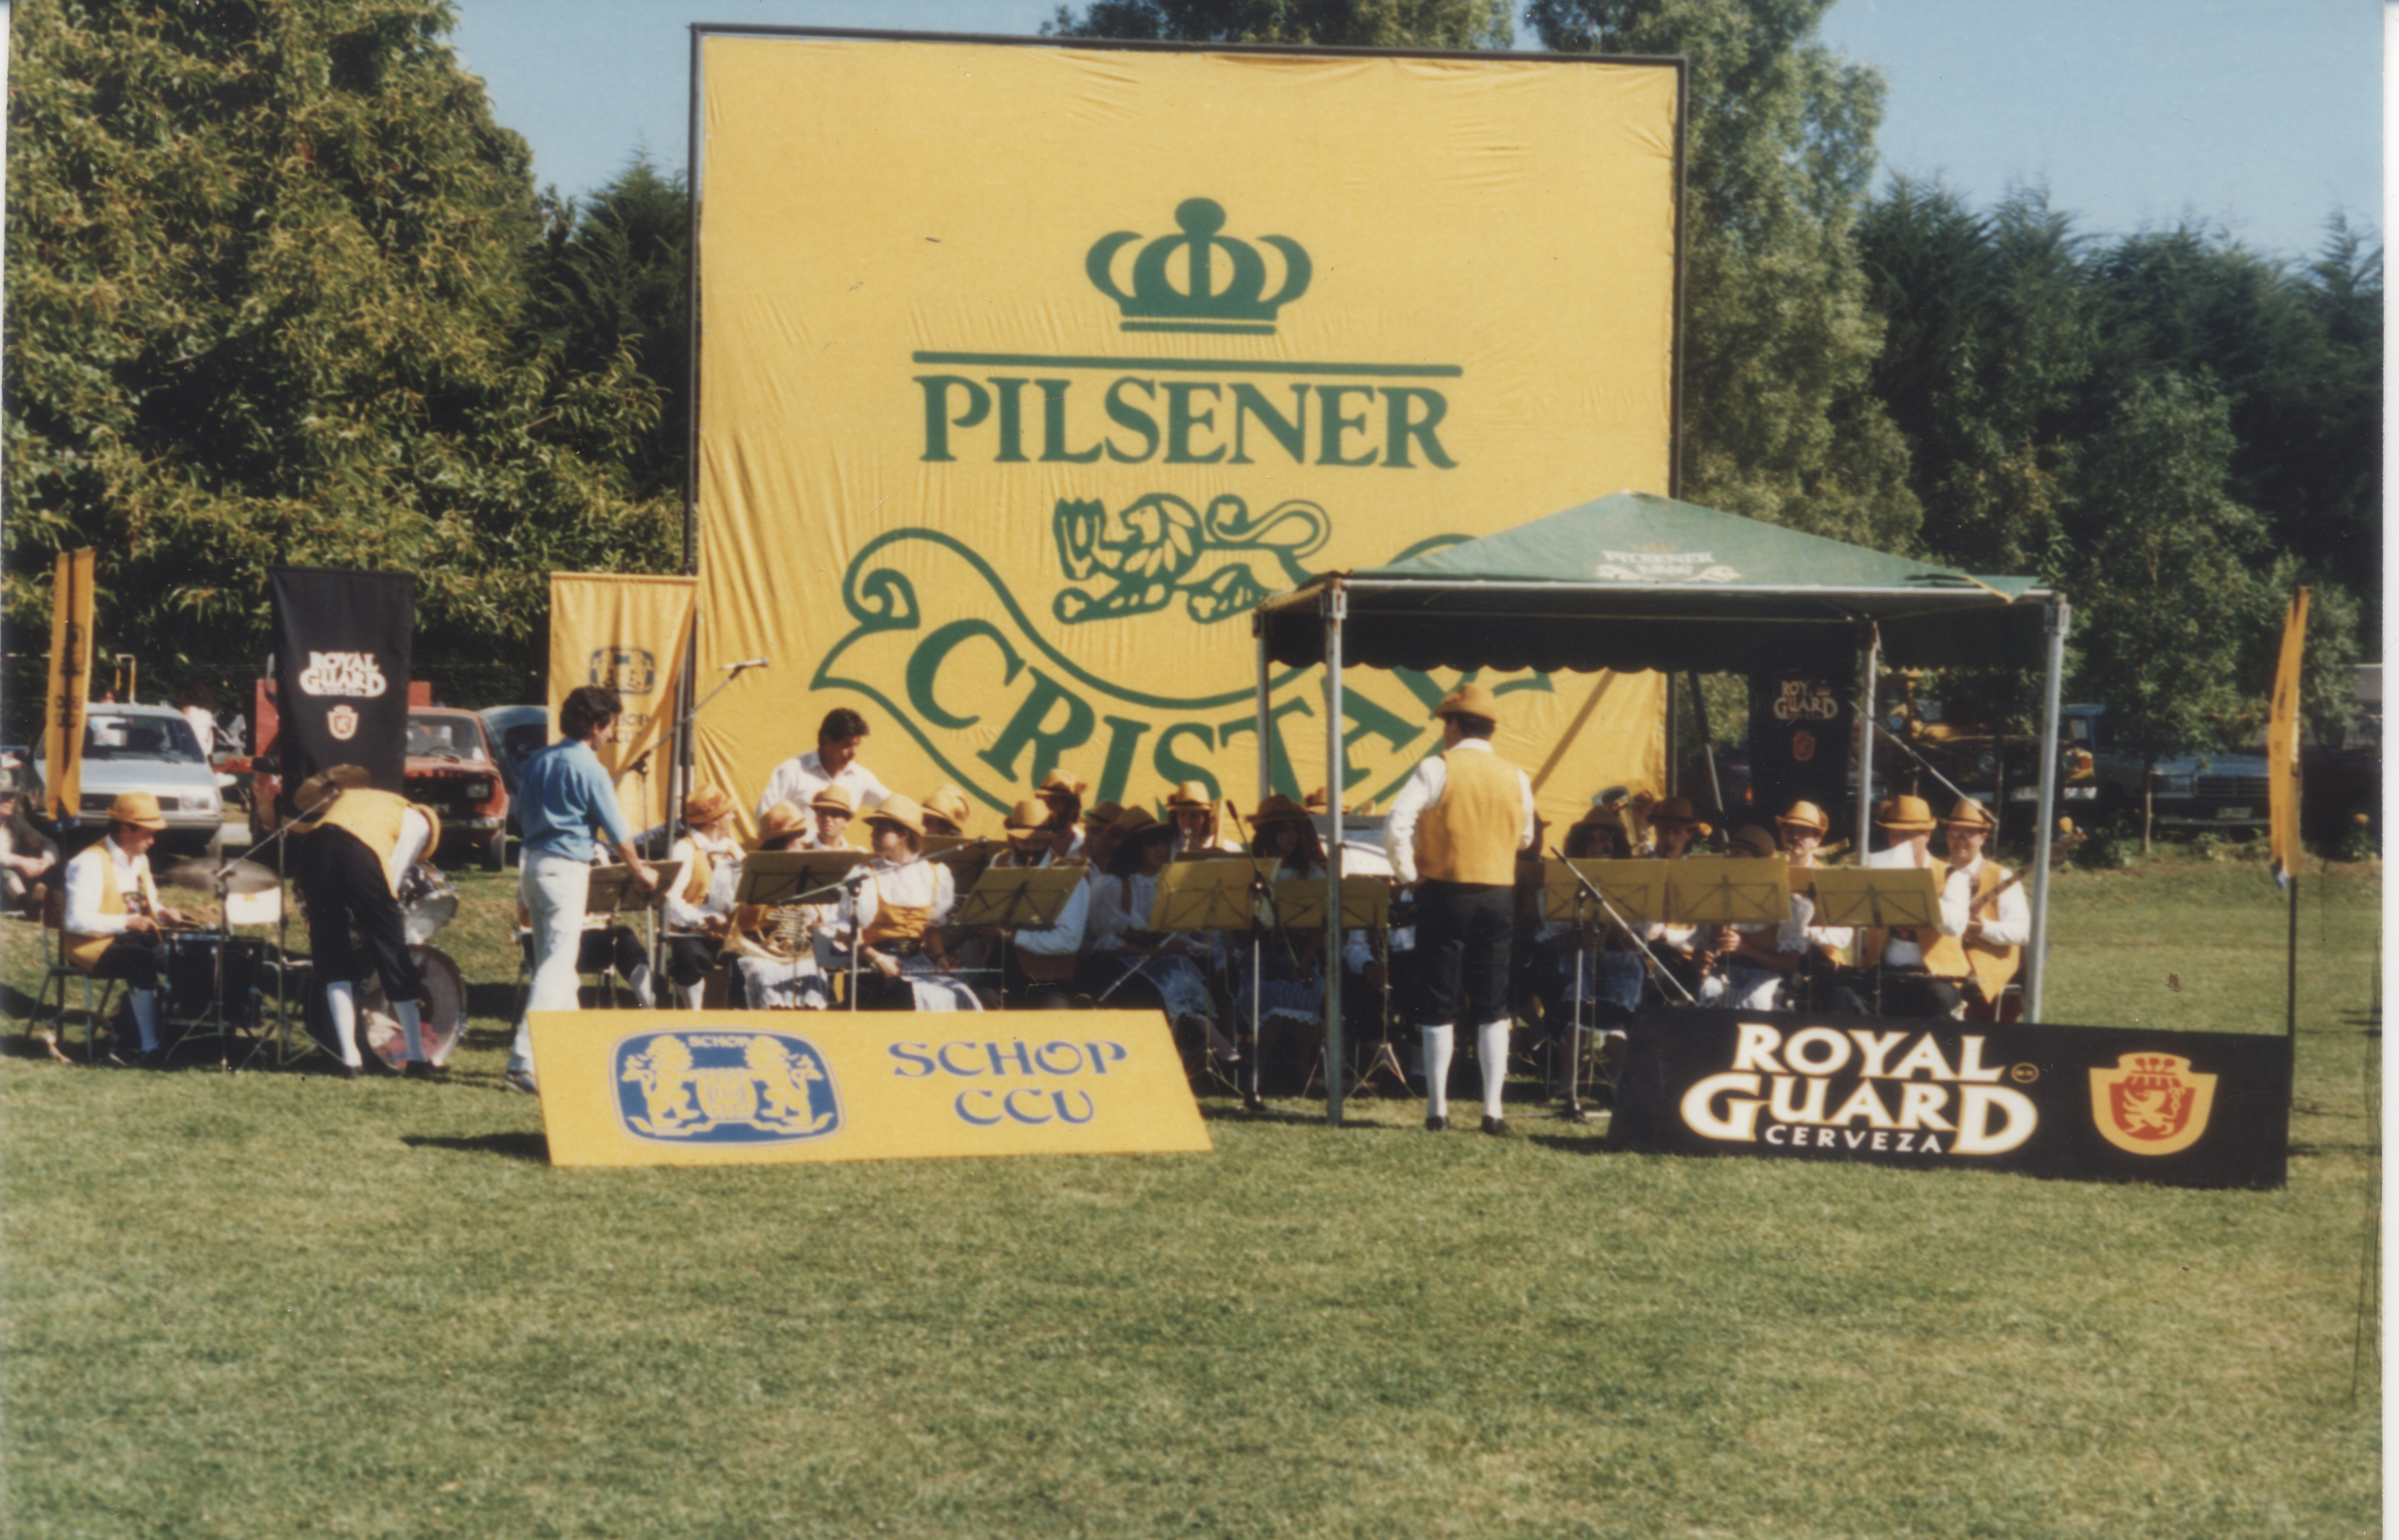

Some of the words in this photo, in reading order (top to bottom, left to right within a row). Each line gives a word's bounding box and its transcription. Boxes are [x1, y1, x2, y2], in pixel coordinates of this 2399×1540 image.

[912, 374, 1460, 469] PILSENER
[309, 651, 380, 671] ROYAL
[300, 669, 387, 697] GUARD
[1773, 696, 1839, 720] GUARD
[888, 1040, 1127, 1077] SCHOP
[1730, 1023, 2006, 1082] ROYAL
[955, 1088, 1095, 1126] CCU
[1680, 1071, 2039, 1155] GUARD
[1764, 1125, 1942, 1153] CERVEZA
